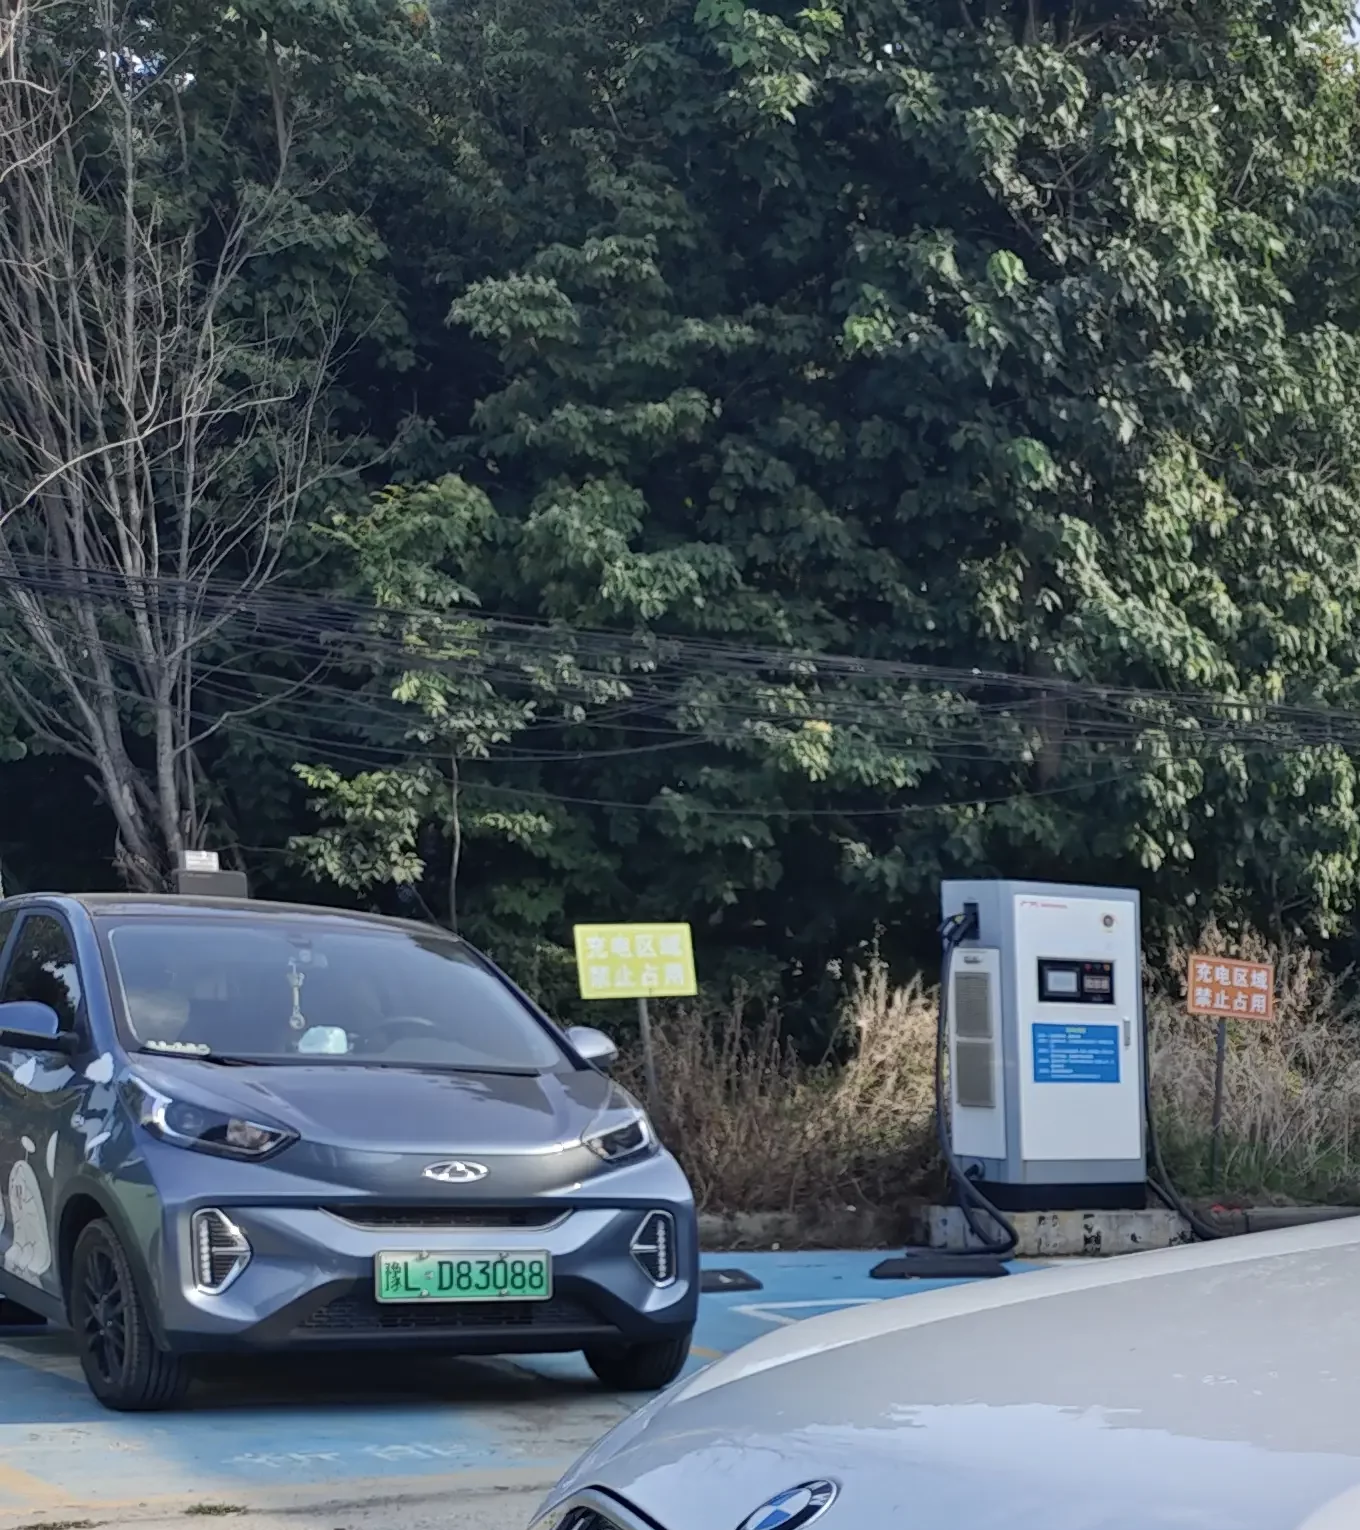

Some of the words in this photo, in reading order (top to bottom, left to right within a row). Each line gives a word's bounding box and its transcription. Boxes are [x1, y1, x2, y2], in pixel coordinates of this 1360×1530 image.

[1195, 962, 1269, 990] 充电区域
[1194, 986, 1267, 1015] 禁止占用
